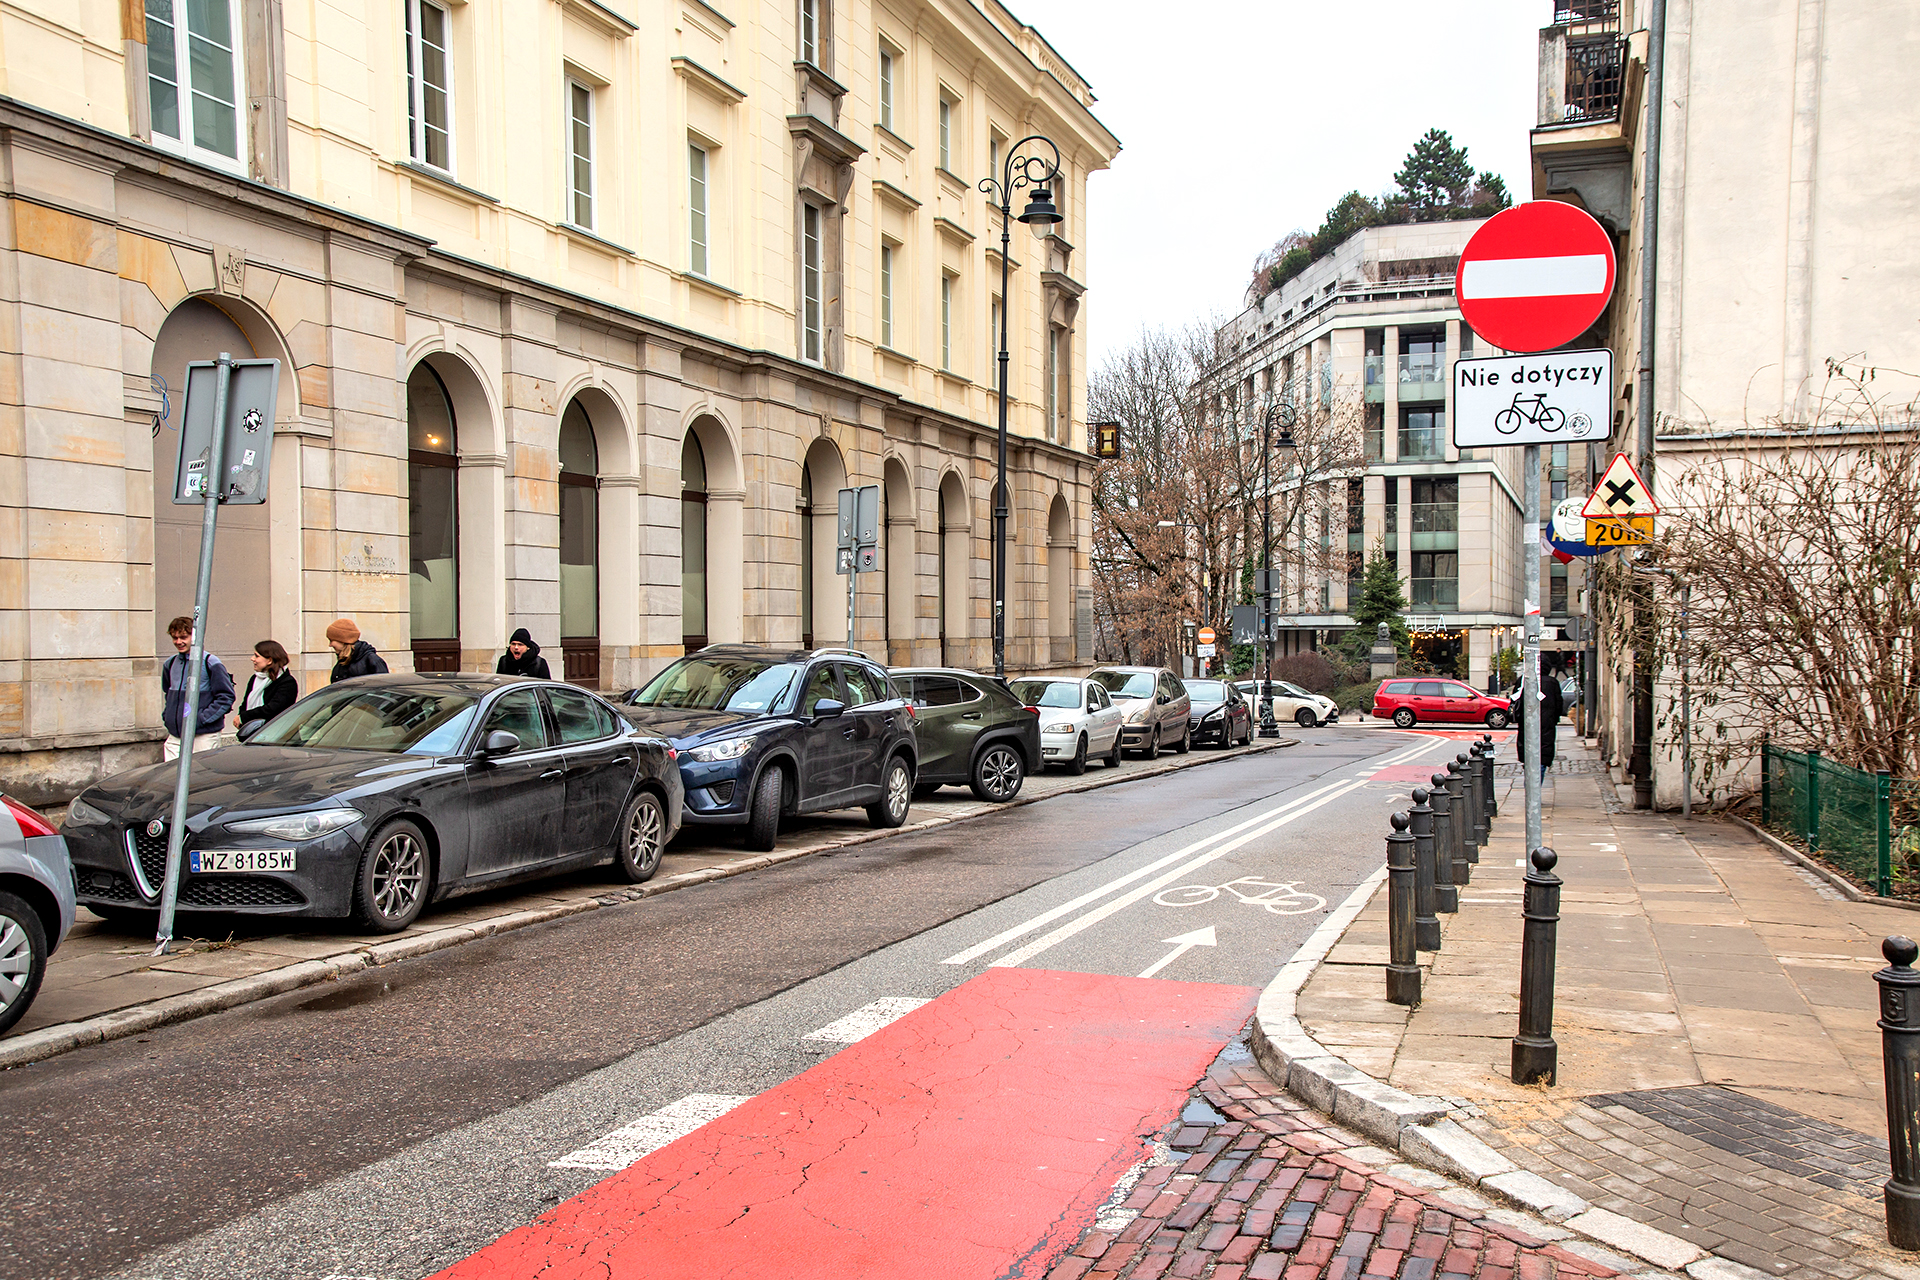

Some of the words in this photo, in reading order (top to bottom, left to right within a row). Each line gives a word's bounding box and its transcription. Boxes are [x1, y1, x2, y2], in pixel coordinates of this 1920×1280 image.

[1461, 368, 1500, 387] Nie
[1511, 364, 1603, 388] dotyczy
[203, 853, 229, 870] WZ
[235, 851, 292, 870] 8185W
